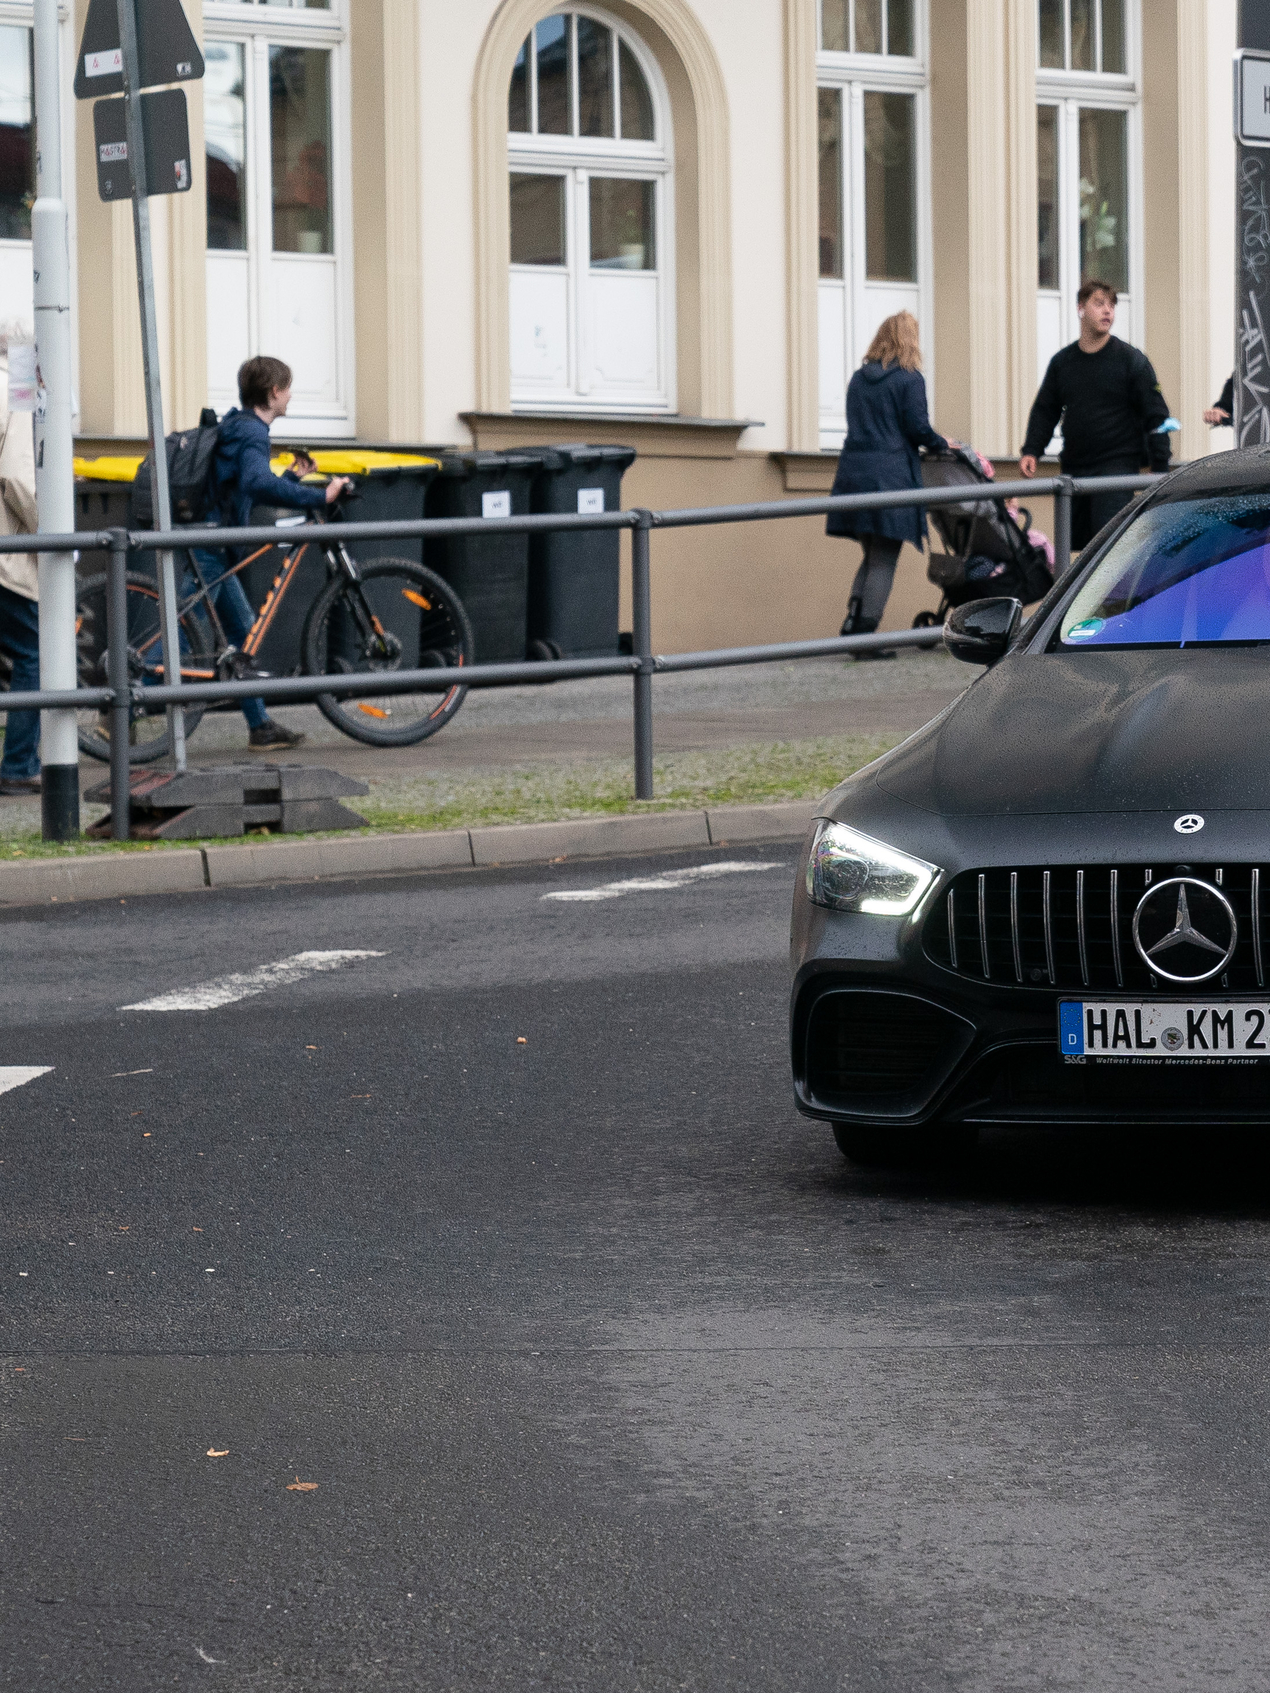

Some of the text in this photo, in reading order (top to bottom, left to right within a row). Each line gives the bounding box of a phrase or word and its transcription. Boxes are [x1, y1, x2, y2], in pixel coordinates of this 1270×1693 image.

[1086, 1008, 1157, 1050] HAL
[1186, 1008, 1236, 1050] KM
[1067, 1033, 1078, 1045] D
[1064, 1054, 1087, 1065] S&G
[1164, 1056, 1226, 1066] Mercedes-Benz
[1227, 1056, 1259, 1066] Partner
